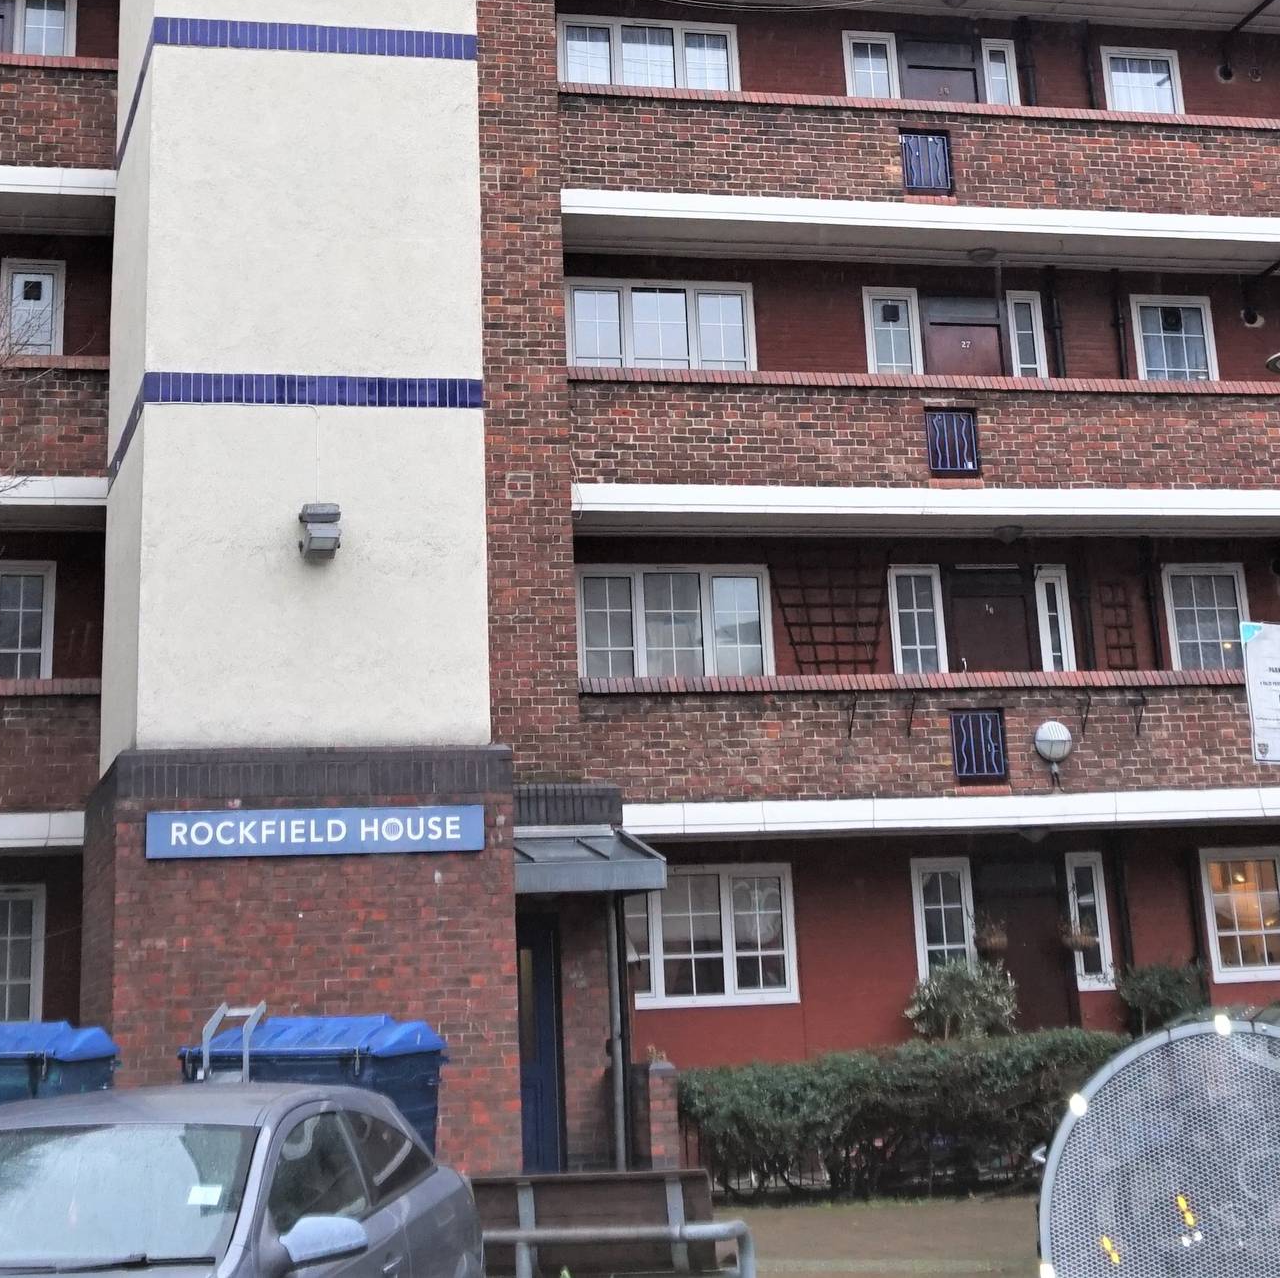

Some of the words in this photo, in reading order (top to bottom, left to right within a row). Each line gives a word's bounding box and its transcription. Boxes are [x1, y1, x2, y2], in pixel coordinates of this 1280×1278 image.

[960, 340, 971, 348] 27
[170, 819, 347, 846] ROCKFIELD
[359, 816, 461, 842] HOUSE
